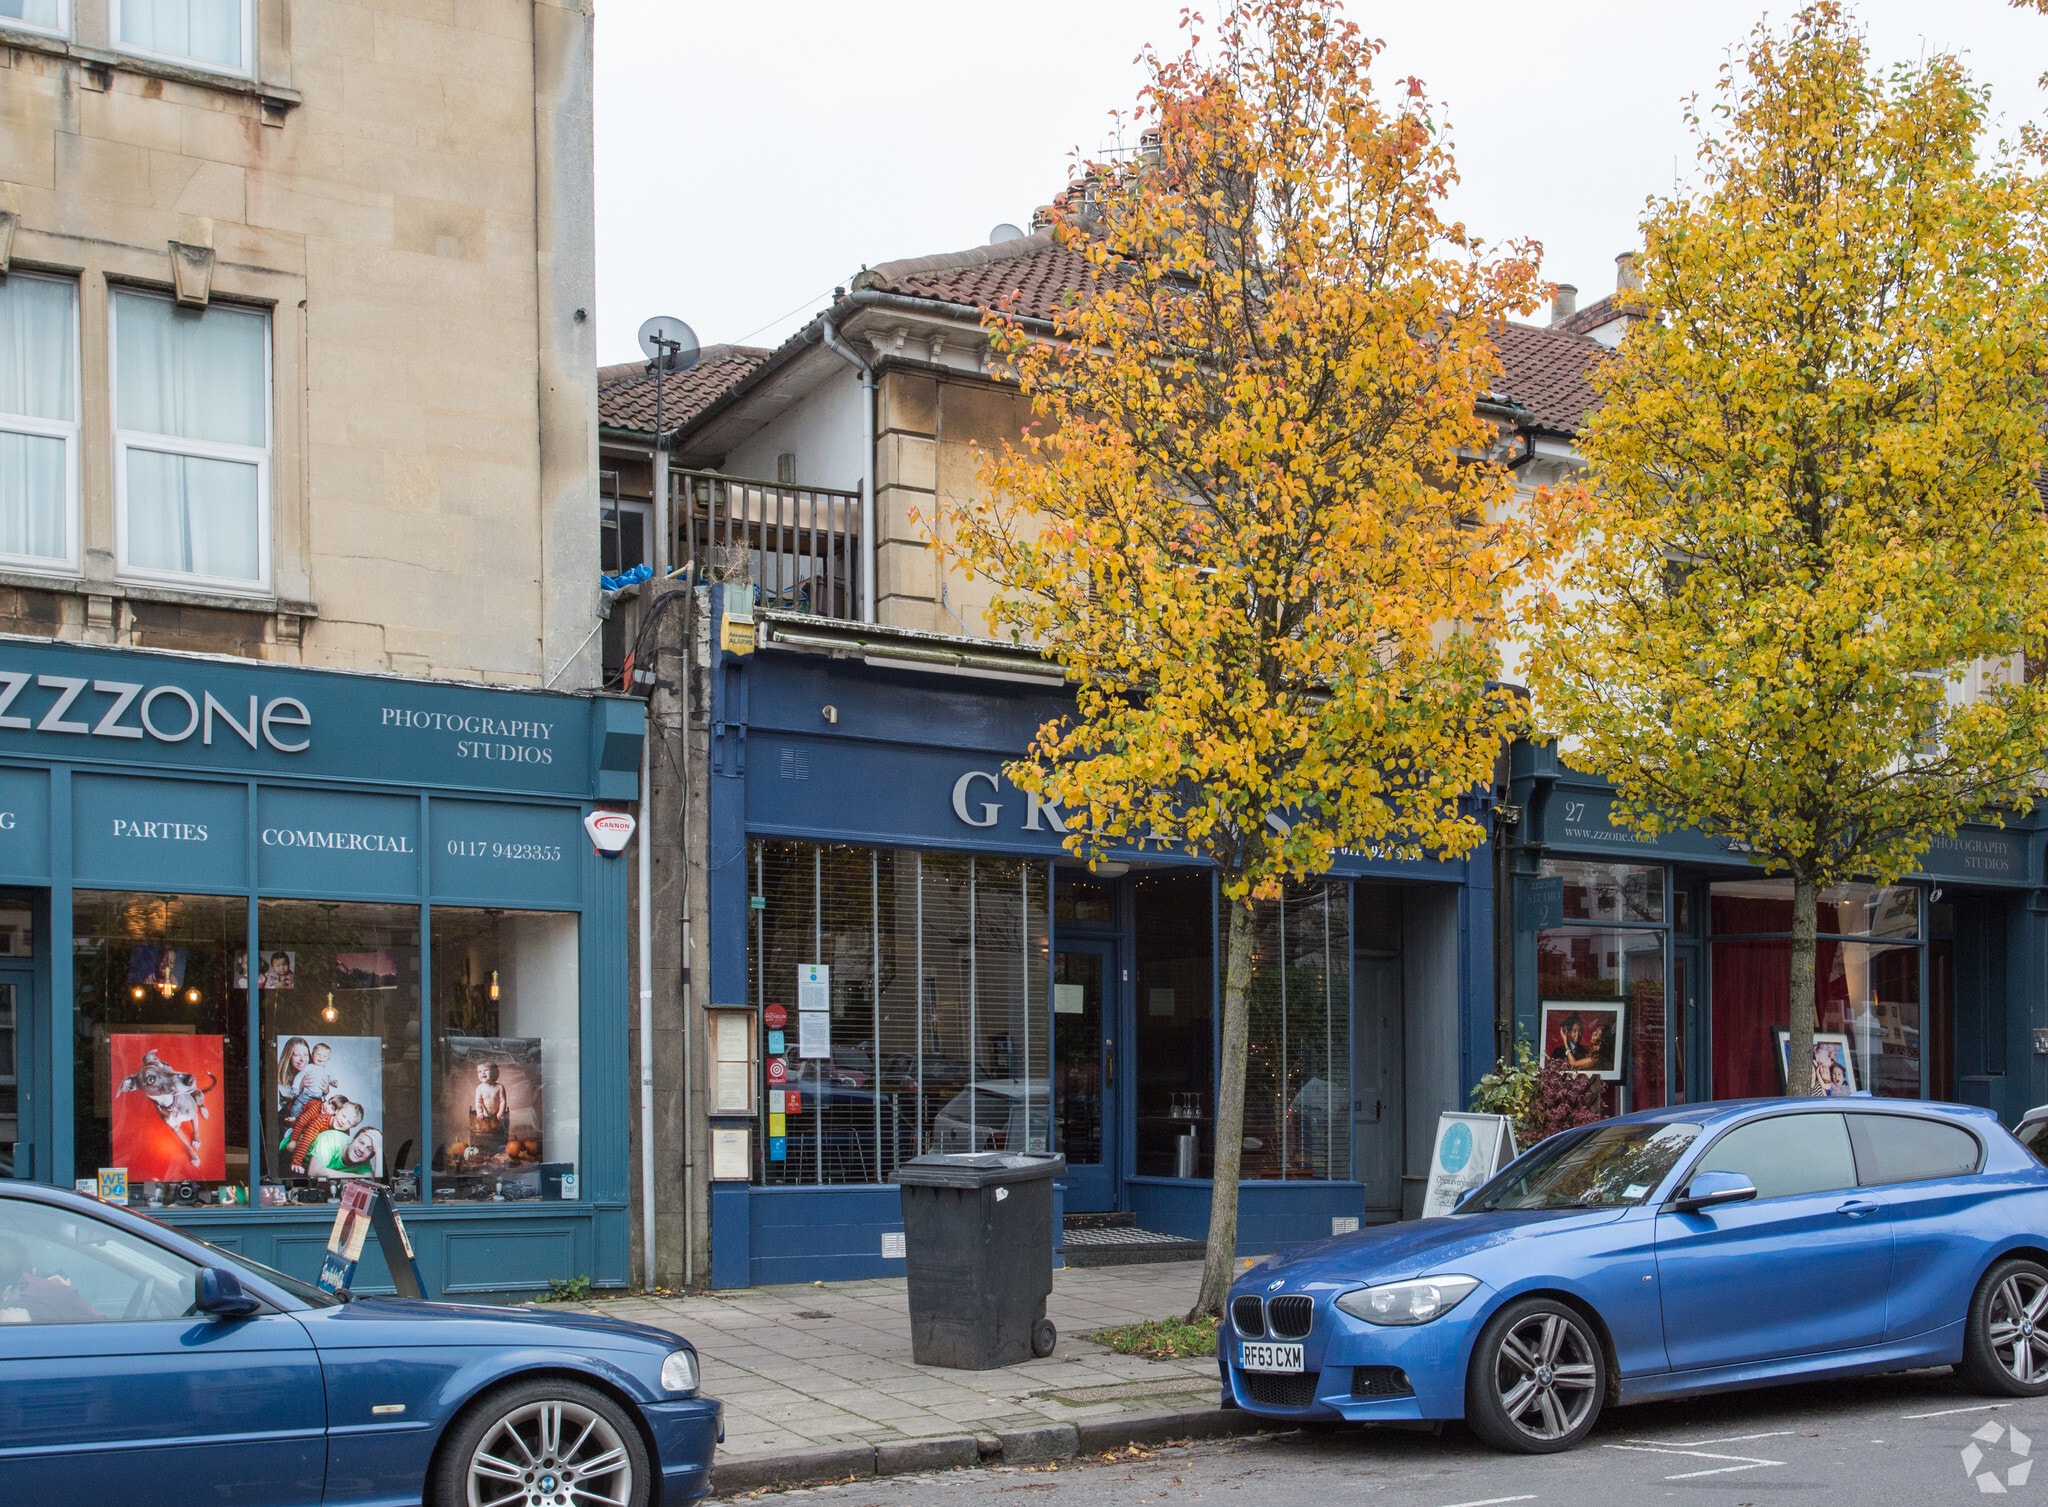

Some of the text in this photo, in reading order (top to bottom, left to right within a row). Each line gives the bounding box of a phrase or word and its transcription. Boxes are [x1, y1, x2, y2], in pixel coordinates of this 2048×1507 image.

[381, 707, 554, 740] PHOTOGRAPHY
[457, 740, 553, 764] STUDIOS
[1565, 801, 1585, 822] 27
[113, 819, 208, 842] PARTIES
[262, 828, 414, 853] COMMERCIAL
[1565, 828, 1659, 845] www.zzzone.cuk
[447, 840, 561, 861] 0117 9423355
[1931, 838, 2008, 854] PHOTOGRAPHY
[1965, 857, 2009, 871] STUDIOS
[1527, 891, 1561, 905] STUDIO
[1540, 904, 1549, 927] 2
[101, 1173, 125, 1185] WE
[1244, 1345, 1301, 1368] RF63 CXM
